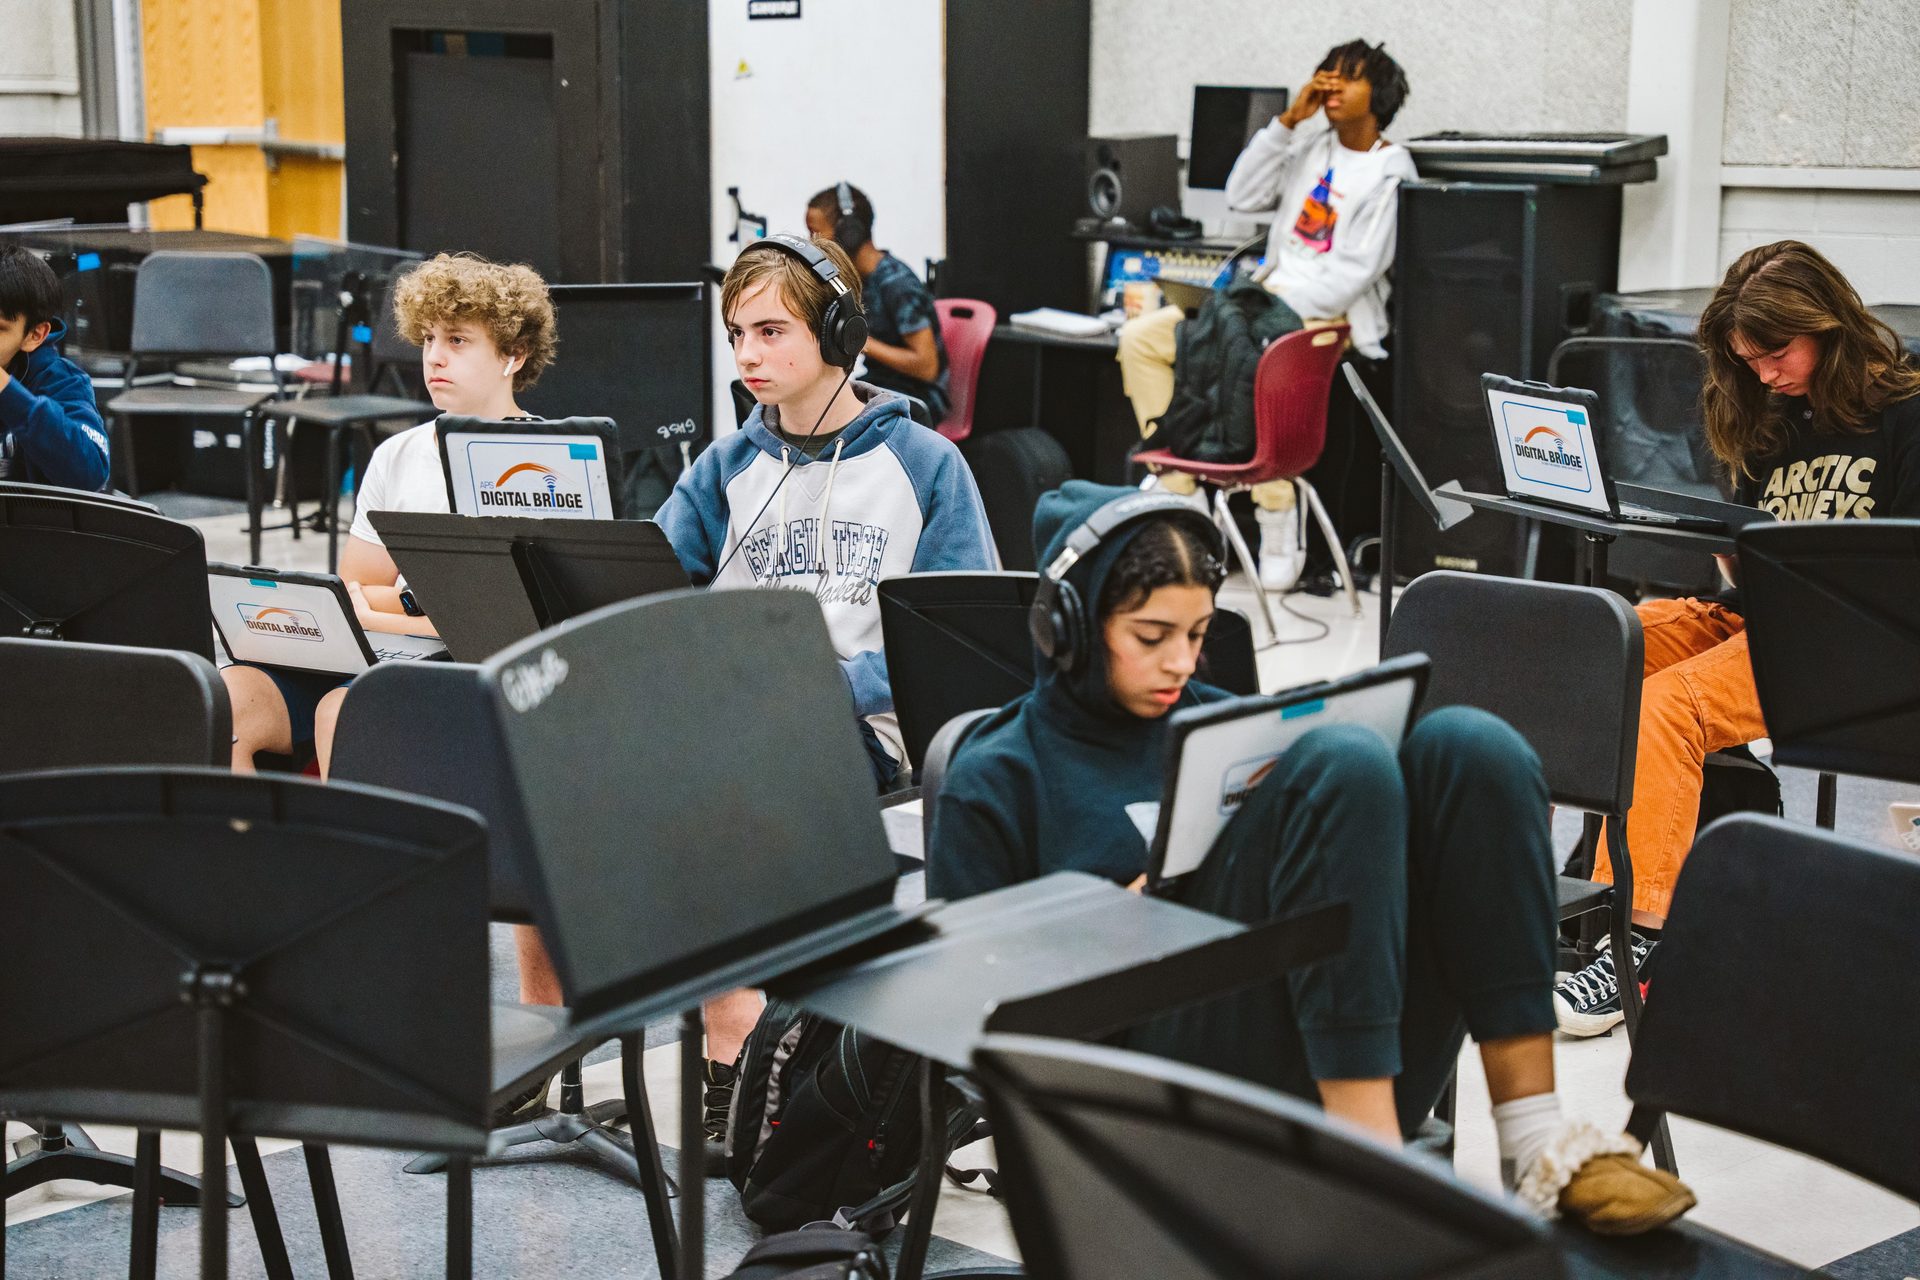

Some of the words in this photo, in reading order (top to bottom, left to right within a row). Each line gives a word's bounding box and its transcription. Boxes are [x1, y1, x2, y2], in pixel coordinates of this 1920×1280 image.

[1515, 444, 1548, 462] DIGITAL
[1548, 447, 1582, 468] BRIDGE
[480, 481, 494, 489] APS
[1764, 454, 1877, 497] ARCTIC
[480, 491, 531, 507] DIGITAL
[533, 489, 583, 509] BRIDGE
[832, 519, 889, 587] TECH
[246, 620, 284, 633] DIGITAL
[284, 624, 321, 637] BRIDGE
